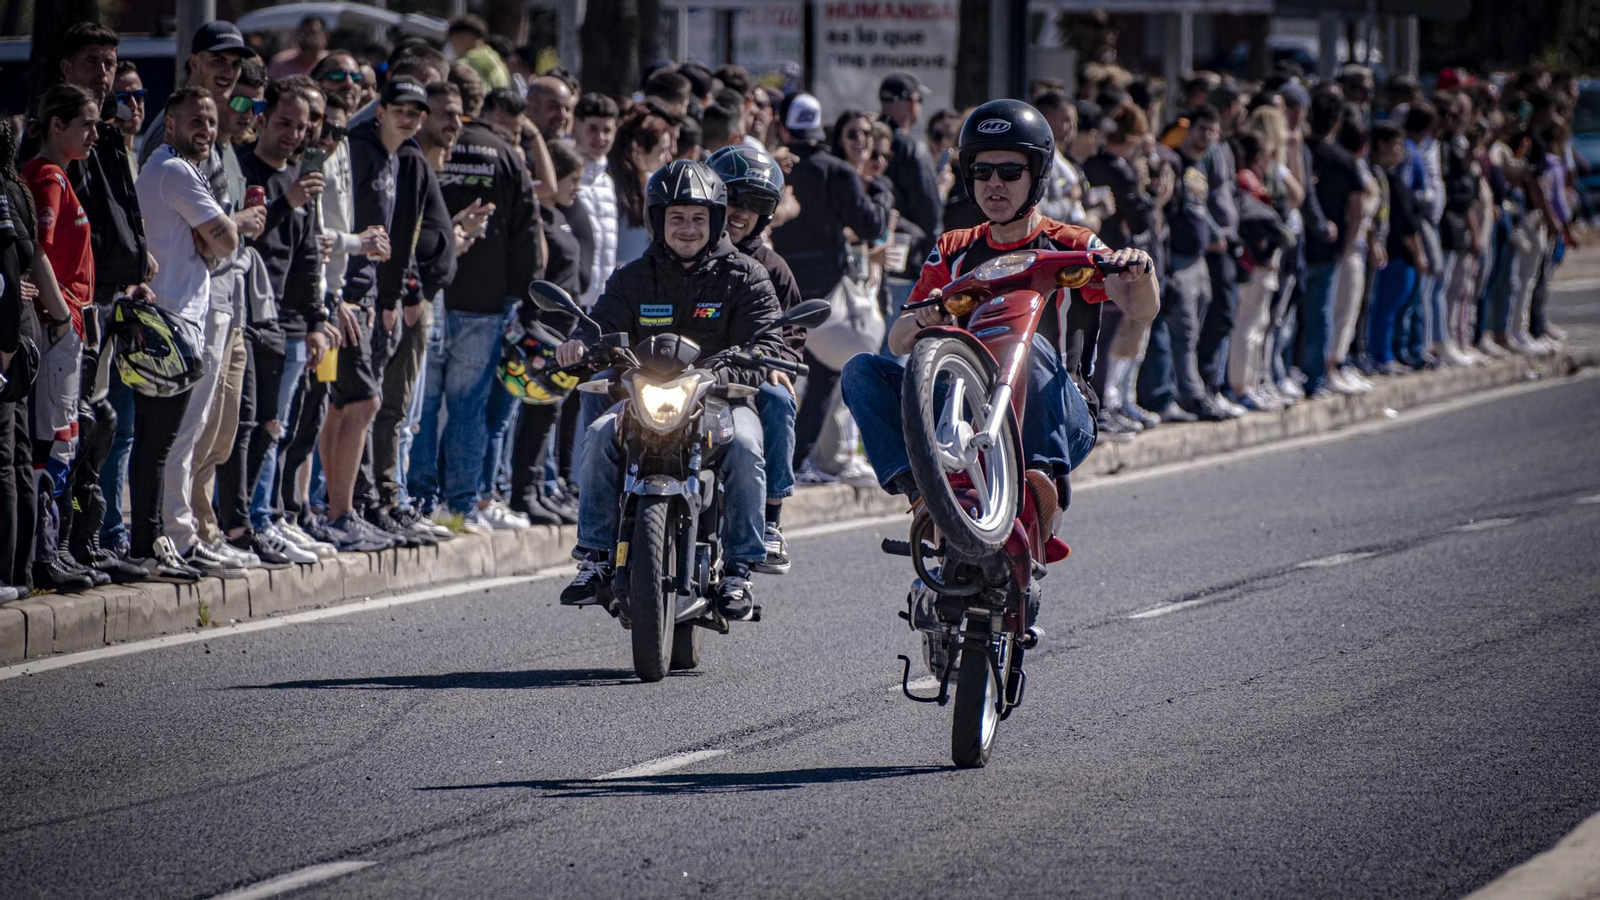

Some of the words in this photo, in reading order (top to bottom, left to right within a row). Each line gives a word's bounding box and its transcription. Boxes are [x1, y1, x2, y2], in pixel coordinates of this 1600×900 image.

[825, 3, 959, 21] HUMANIDA
[827, 29, 850, 45] es
[855, 23, 877, 44] lo
[881, 30, 925, 49] que
[443, 163, 495, 176] awasaki
